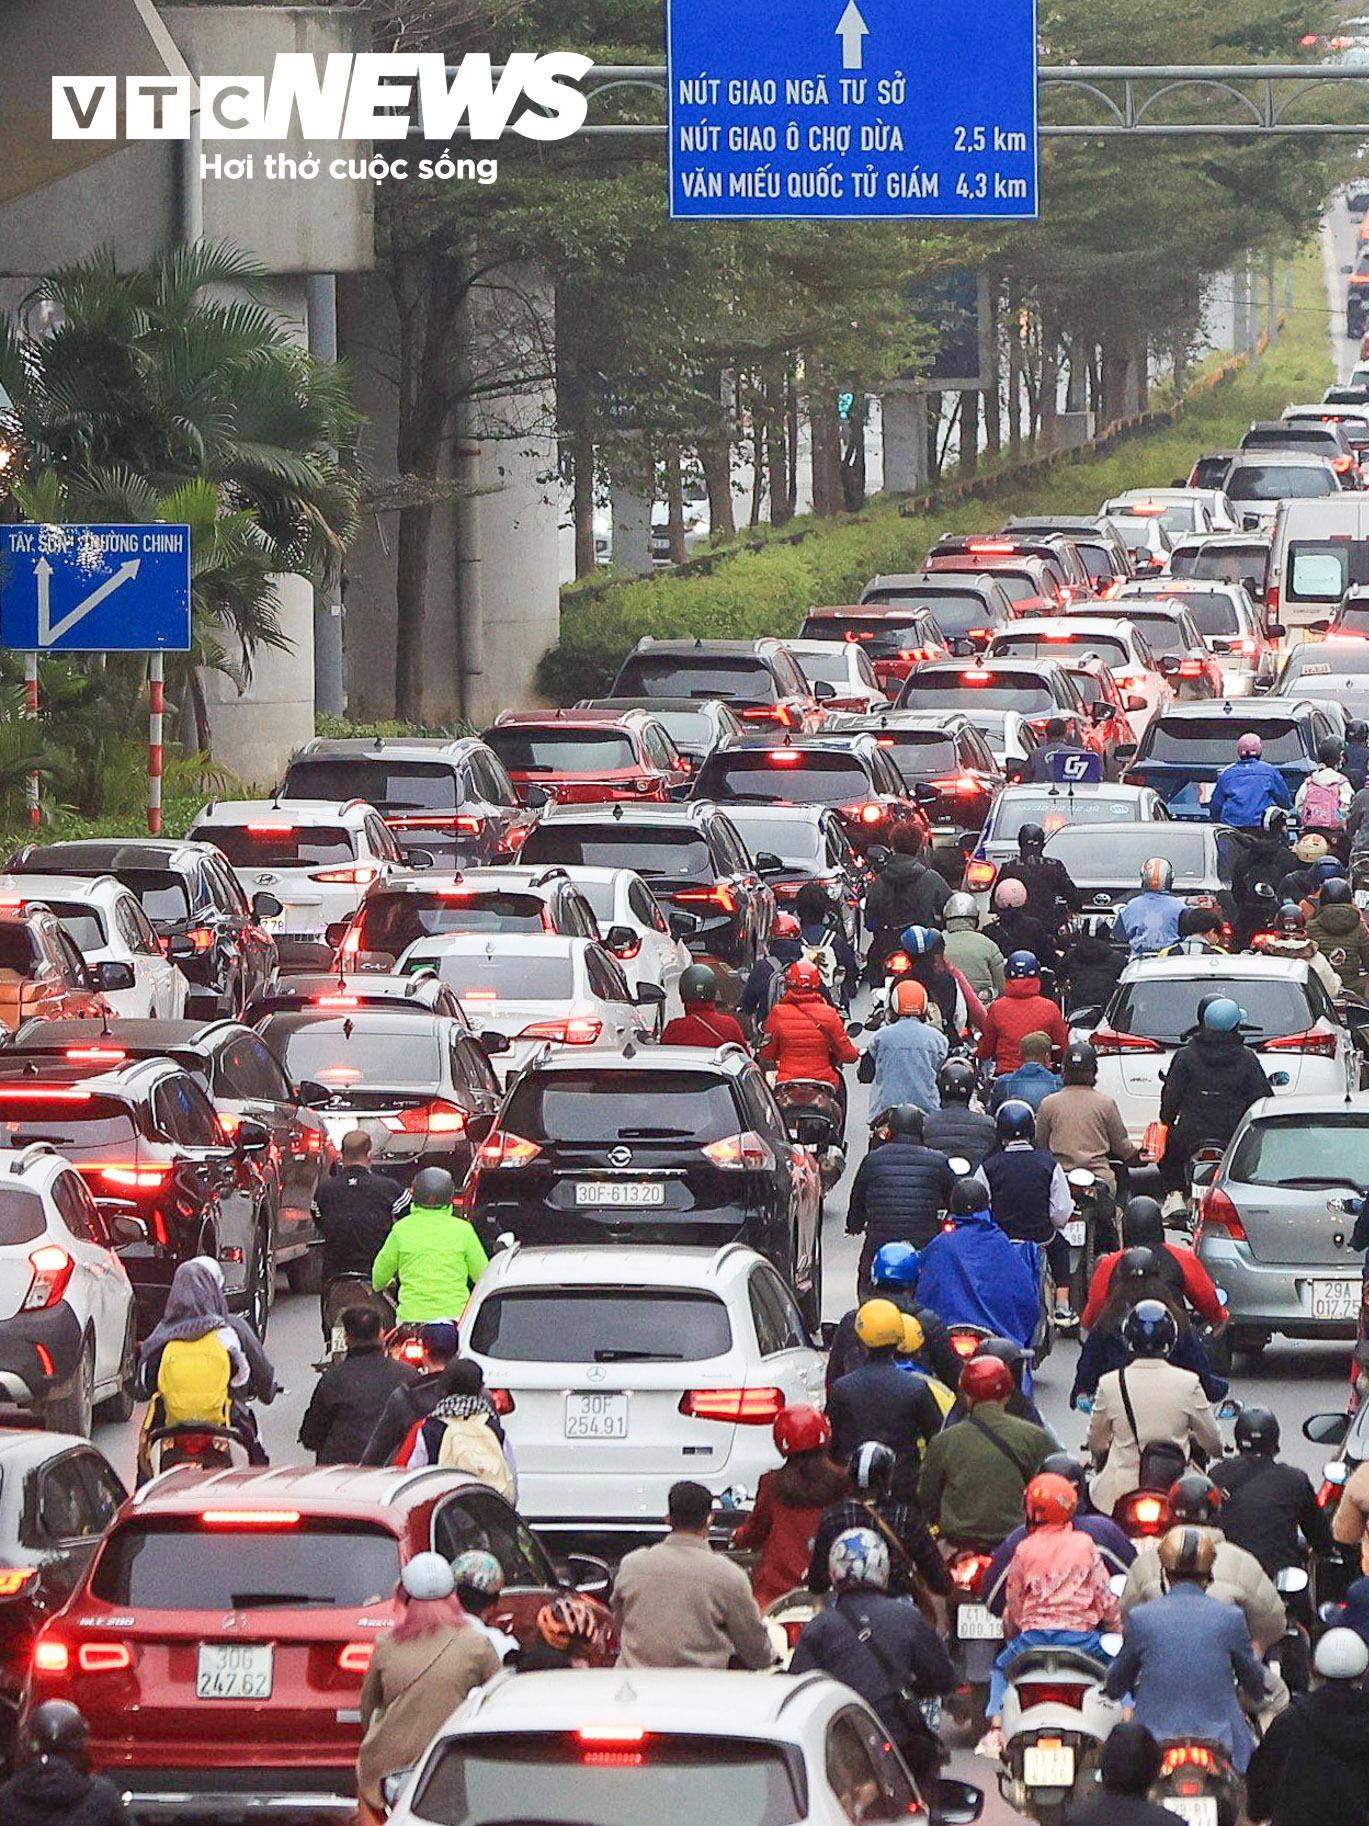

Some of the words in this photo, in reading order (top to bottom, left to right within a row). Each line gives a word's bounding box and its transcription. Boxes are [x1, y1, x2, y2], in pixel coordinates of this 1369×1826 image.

[679, 71, 721, 105] NÚT
[728, 79, 777, 105] GIAO
[786, 73, 830, 105] NGÃ
[839, 79, 868, 105] TƯ
[877, 70, 907, 105] SỞ
[680, 118, 722, 152] NÚT
[728, 126, 777, 152] GIAO
[786, 121, 800, 152] Ô
[808, 125, 851, 157] CHỢ
[861, 118, 905, 152] DỪA
[954, 126, 986, 154] 2,5
[993, 126, 1027, 152] km
[681, 166, 722, 198] VĂN
[729, 163, 780, 198] MIẾU
[788, 163, 844, 198] QUỐC
[851, 164, 880, 198] TỬ
[886, 165, 939, 198] GIÁM
[955, 173, 988, 200] 4,3
[994, 173, 1027, 198] km
[9, 530, 33, 553] TÂY
[143, 533, 183, 553] CHINH
[1064, 755, 1089, 780] G7
[1325, 1282, 1351, 1299] 29A
[1316, 1300, 1361, 1316] 017.75
[580, 1397, 612, 1414] 30F
[567, 1416, 624, 1435] 254.91
[200, 1672, 267, 1697] 247.62
